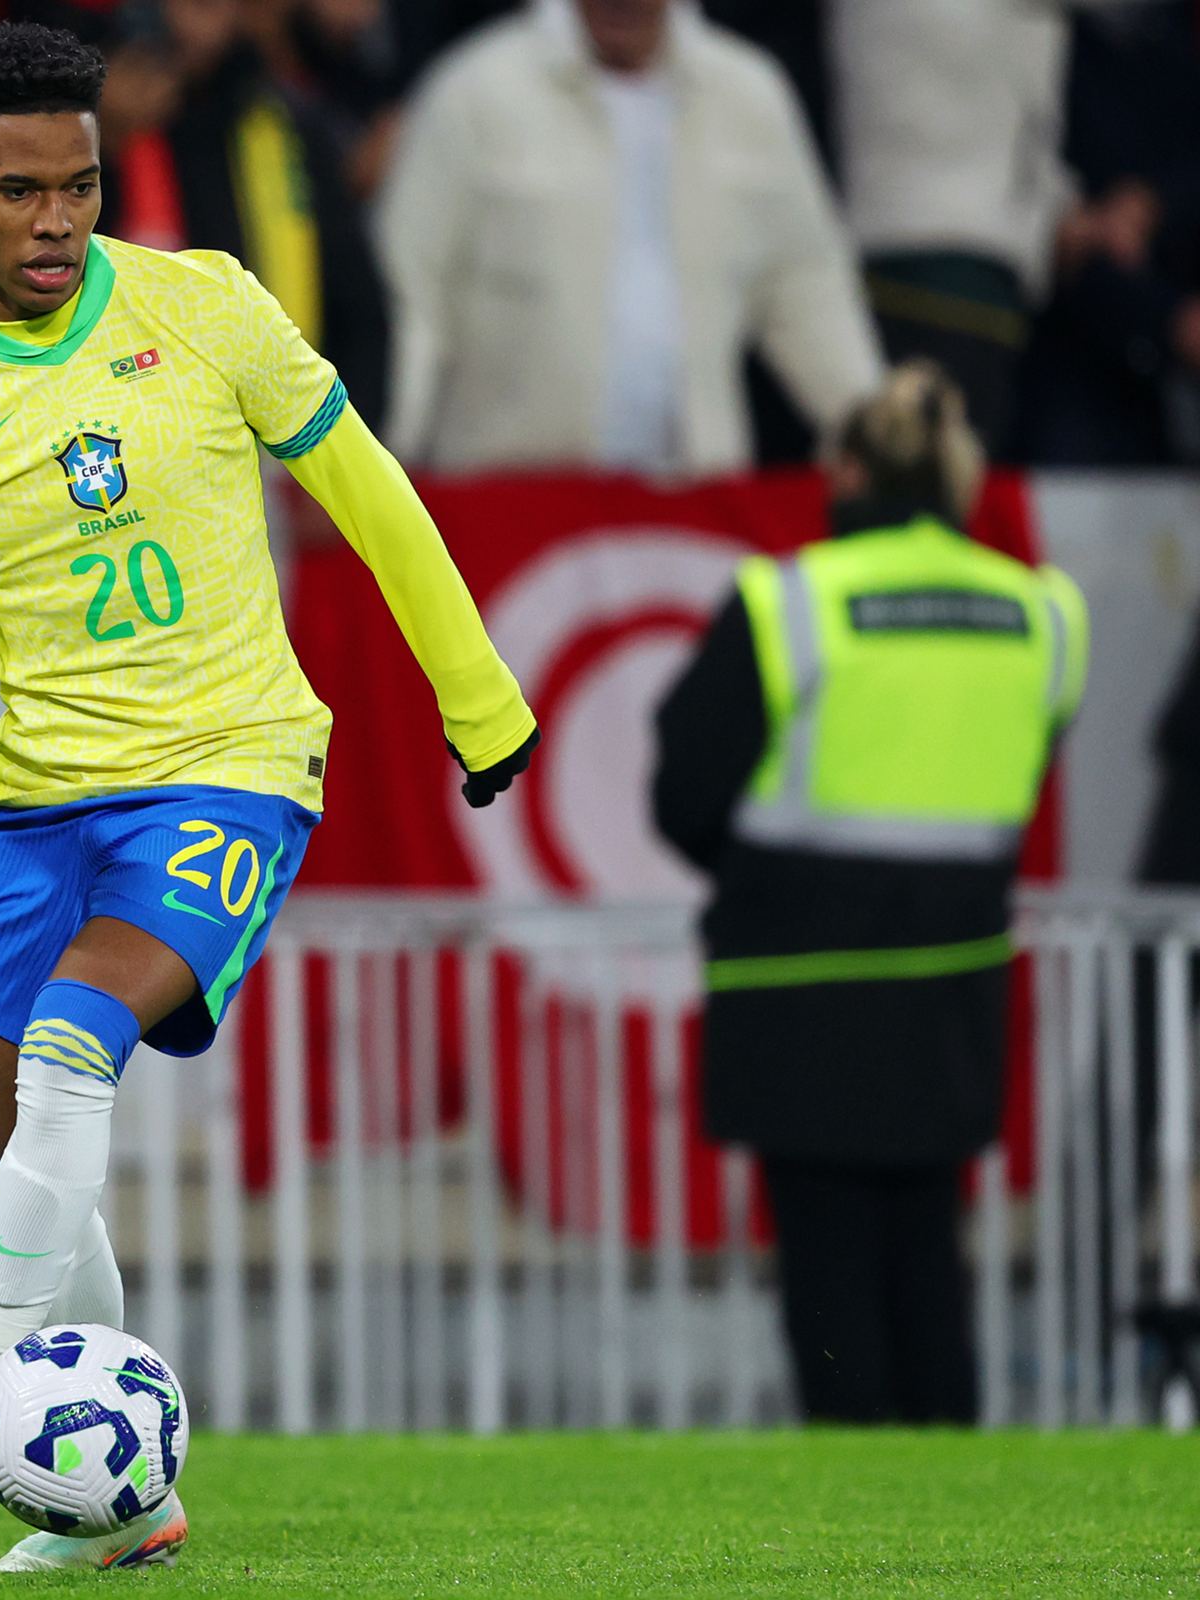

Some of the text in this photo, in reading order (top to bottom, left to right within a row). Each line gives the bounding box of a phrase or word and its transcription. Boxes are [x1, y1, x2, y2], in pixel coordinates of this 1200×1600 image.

[81, 463, 105, 478] CBF
[78, 509, 146, 536] BRASIL
[70, 540, 184, 642] 20
[166, 820, 260, 917] 20
